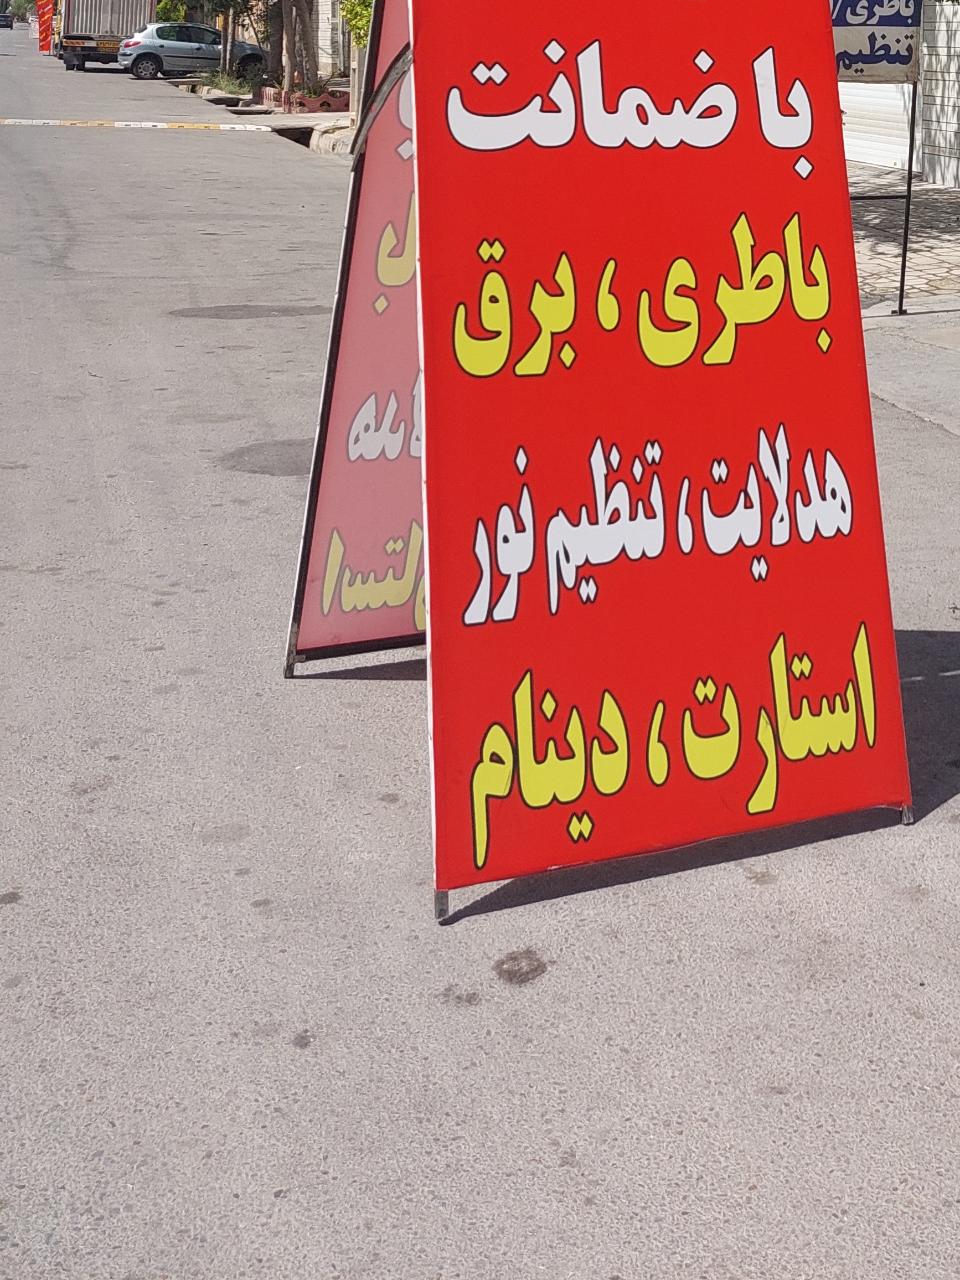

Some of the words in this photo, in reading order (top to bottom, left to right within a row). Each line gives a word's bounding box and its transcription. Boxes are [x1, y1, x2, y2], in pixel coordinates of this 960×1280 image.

[445, 38, 738, 151] ضمانت
[751, 46, 814, 179] با
[836, 31, 915, 74] تنظیم
[453, 237, 578, 378] برق
[637, 211, 831, 368] باطری
[462, 445, 535, 626] نور
[545, 436, 666, 616] تنظیم
[471, 668, 630, 871] دینام
[682, 621, 877, 816] استارت
